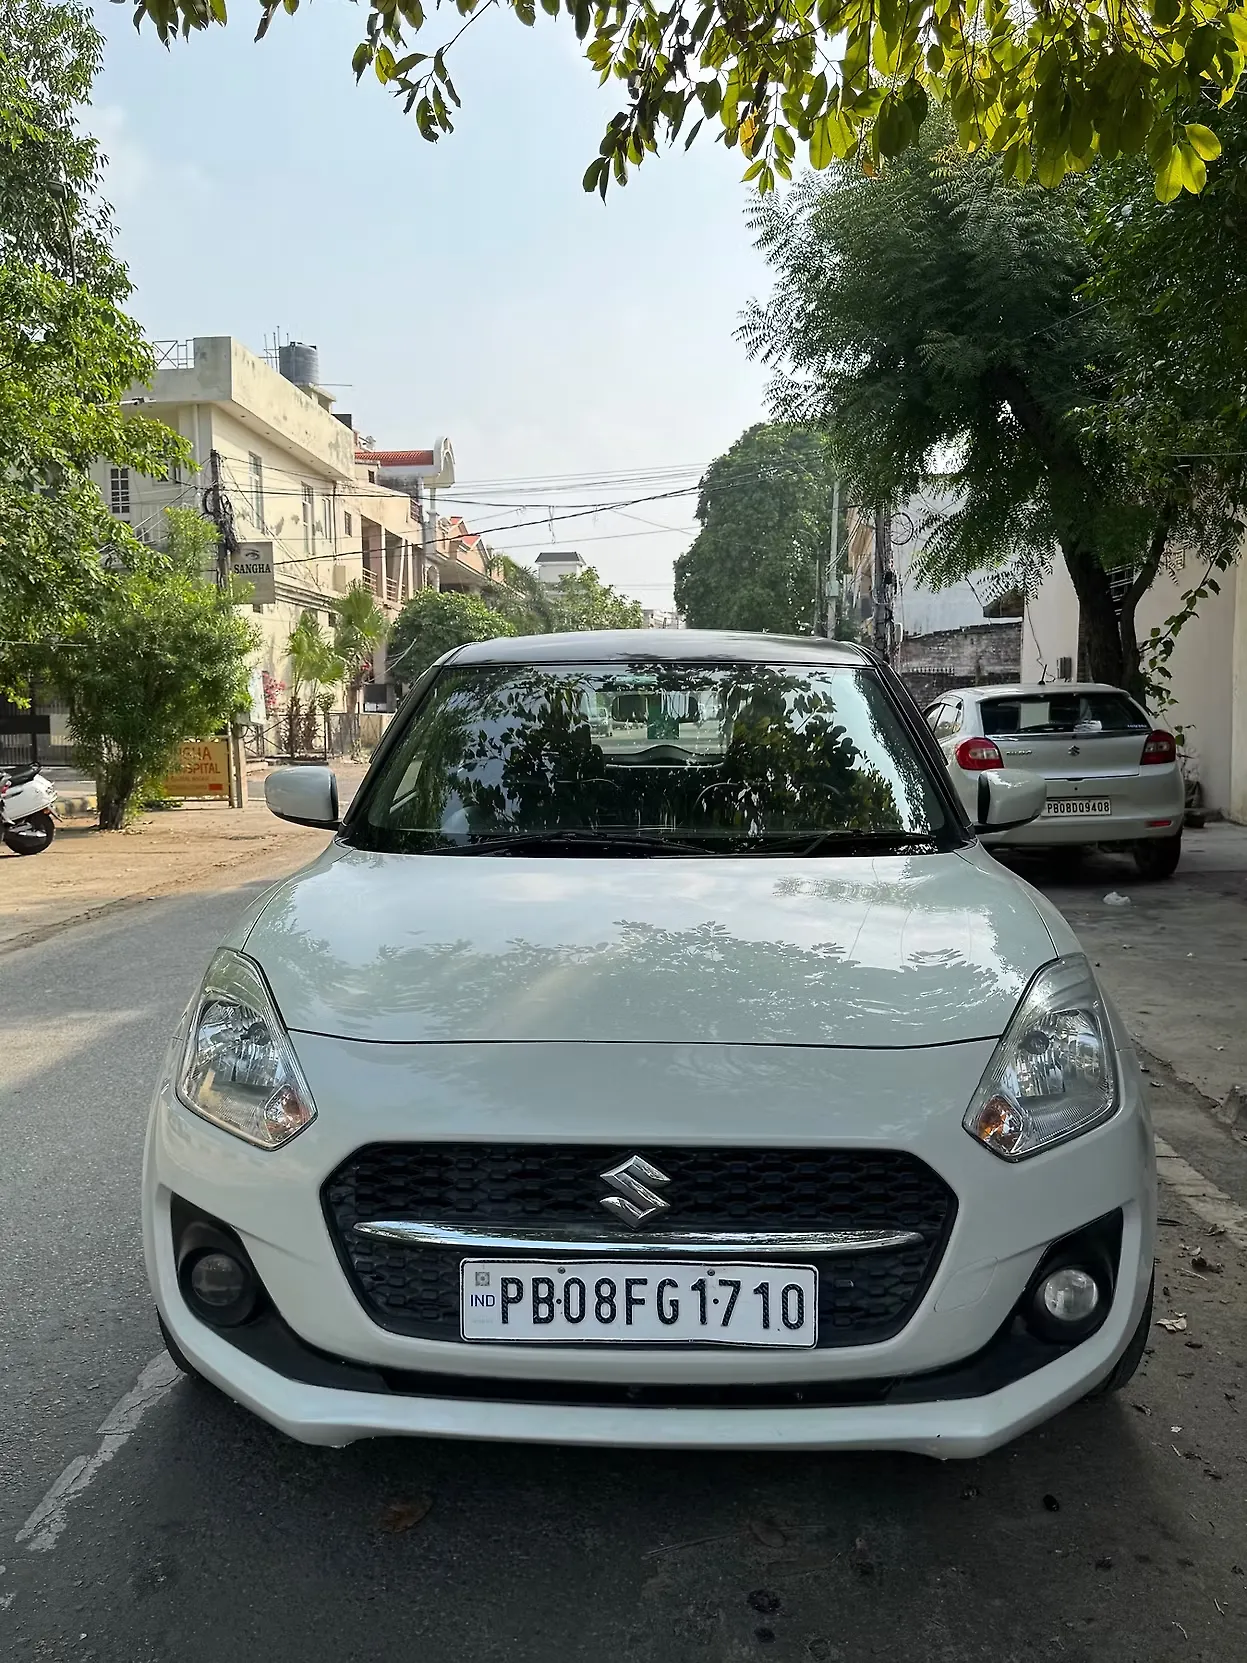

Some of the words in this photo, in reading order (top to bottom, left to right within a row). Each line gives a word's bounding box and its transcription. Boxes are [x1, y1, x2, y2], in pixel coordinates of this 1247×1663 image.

[234, 564, 271, 574] SANGHA
[470, 1294, 495, 1307] IND
[500, 1277, 805, 1331] PB08FG1710
